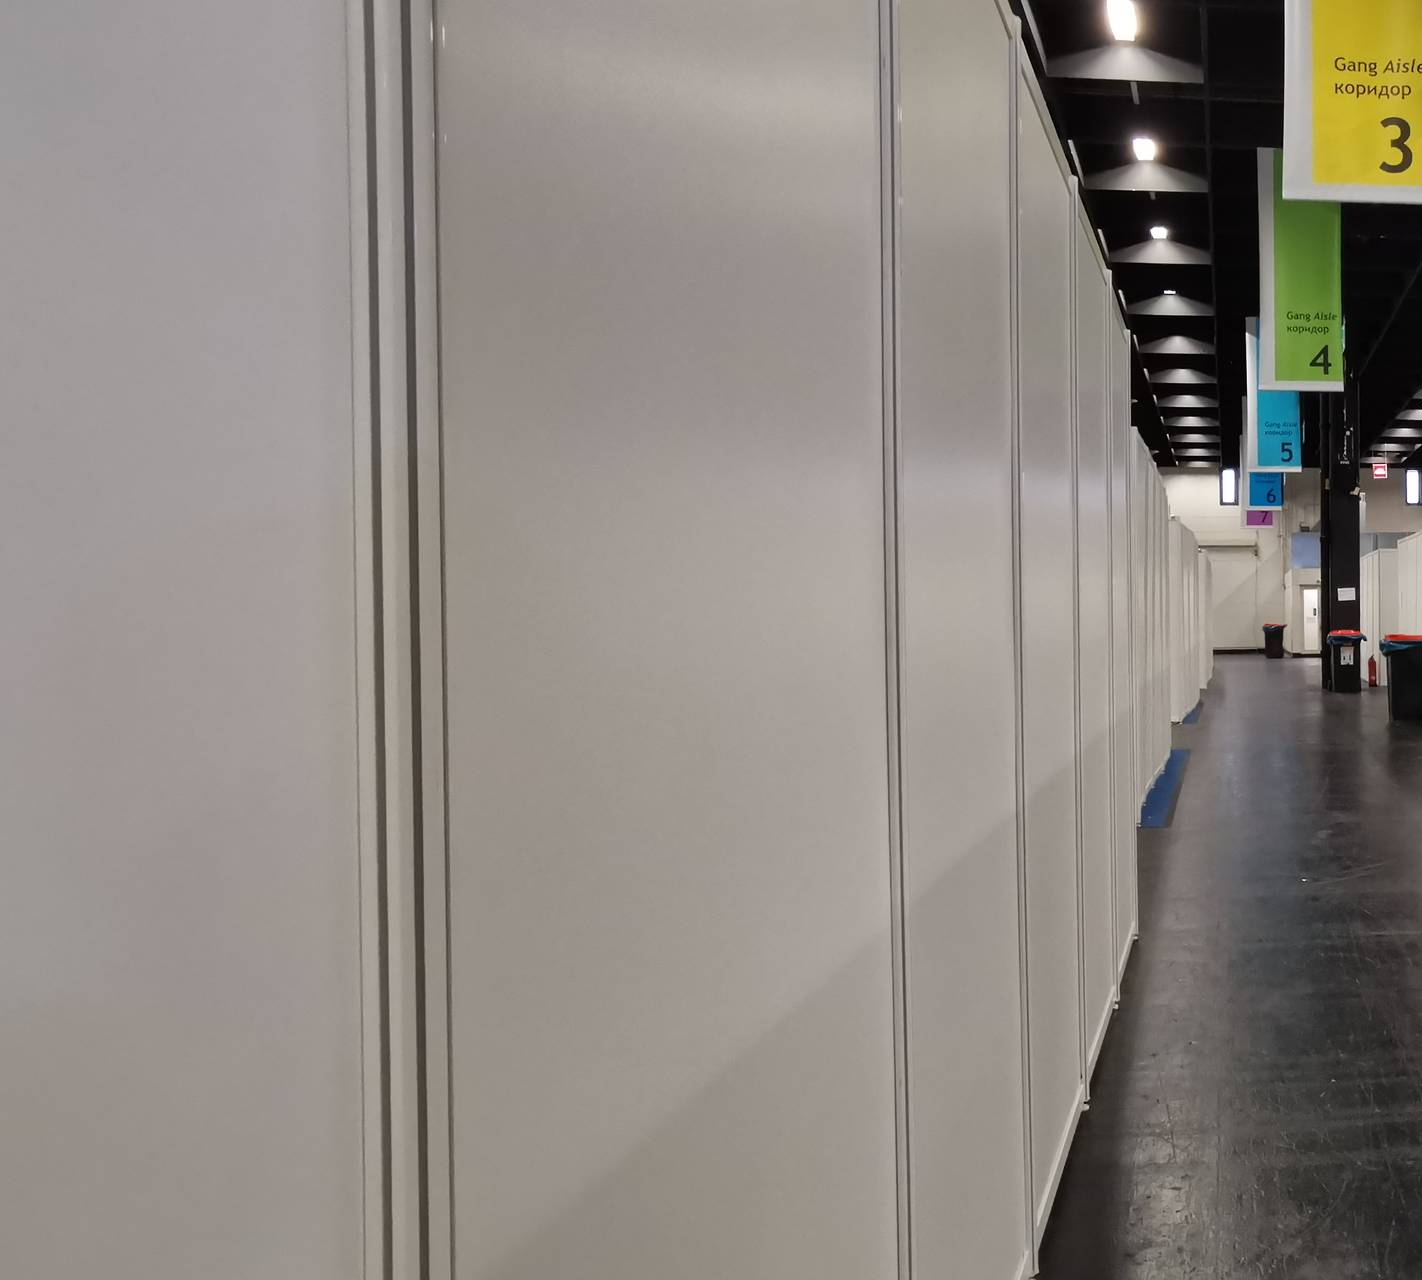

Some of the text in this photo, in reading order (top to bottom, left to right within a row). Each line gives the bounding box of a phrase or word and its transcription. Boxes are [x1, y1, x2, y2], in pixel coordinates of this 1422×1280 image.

[1334, 57, 1377, 76] Gang
[1334, 83, 1412, 100] коридор
[1379, 116, 1413, 174] 3
[1286, 311, 1338, 323] Gang Aisle
[1286, 326, 1330, 335] коридор
[1309, 345, 1332, 375] 4
[1281, 442, 1293, 462] 5
[1266, 488, 1276, 503] 6
[1260, 511, 1269, 523] 7
